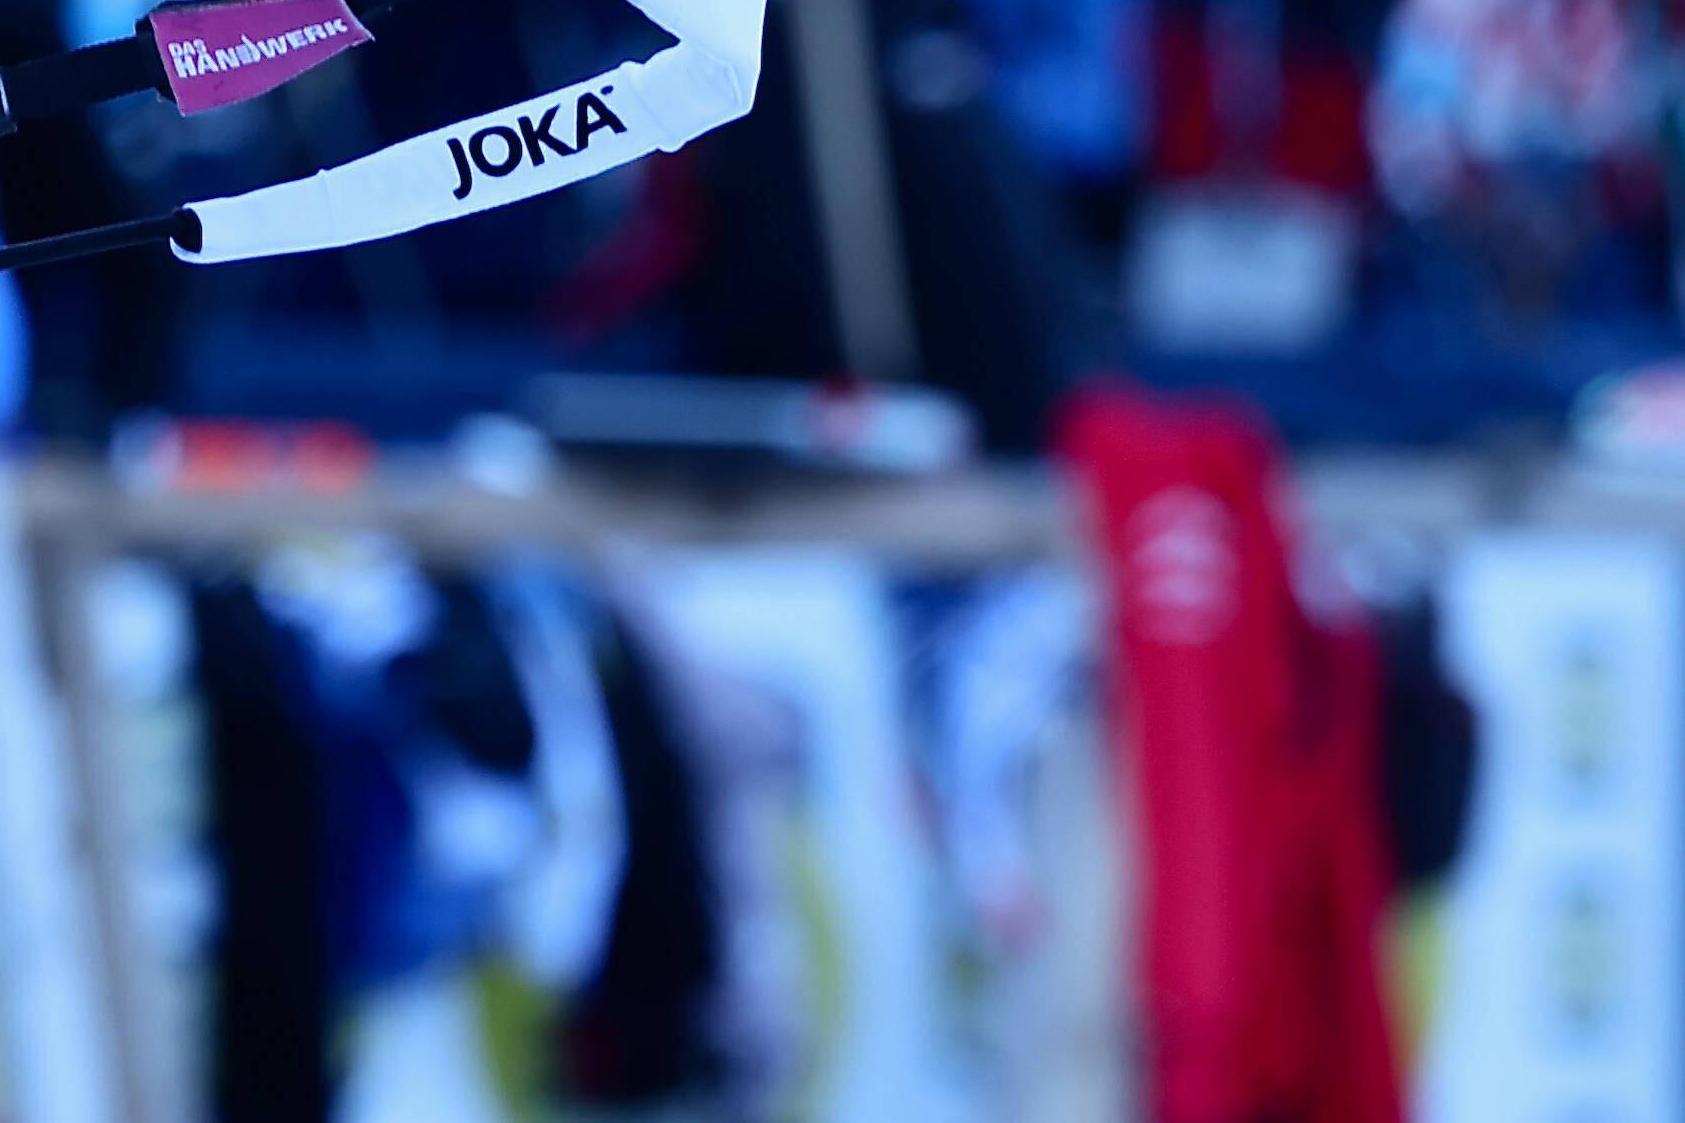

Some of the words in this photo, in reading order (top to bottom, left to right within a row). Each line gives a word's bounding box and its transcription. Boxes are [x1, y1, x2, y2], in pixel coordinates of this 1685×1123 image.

[167, 38, 208, 60] DAS
[173, 18, 348, 79] HANDWERK
[446, 89, 627, 200] JOKA
